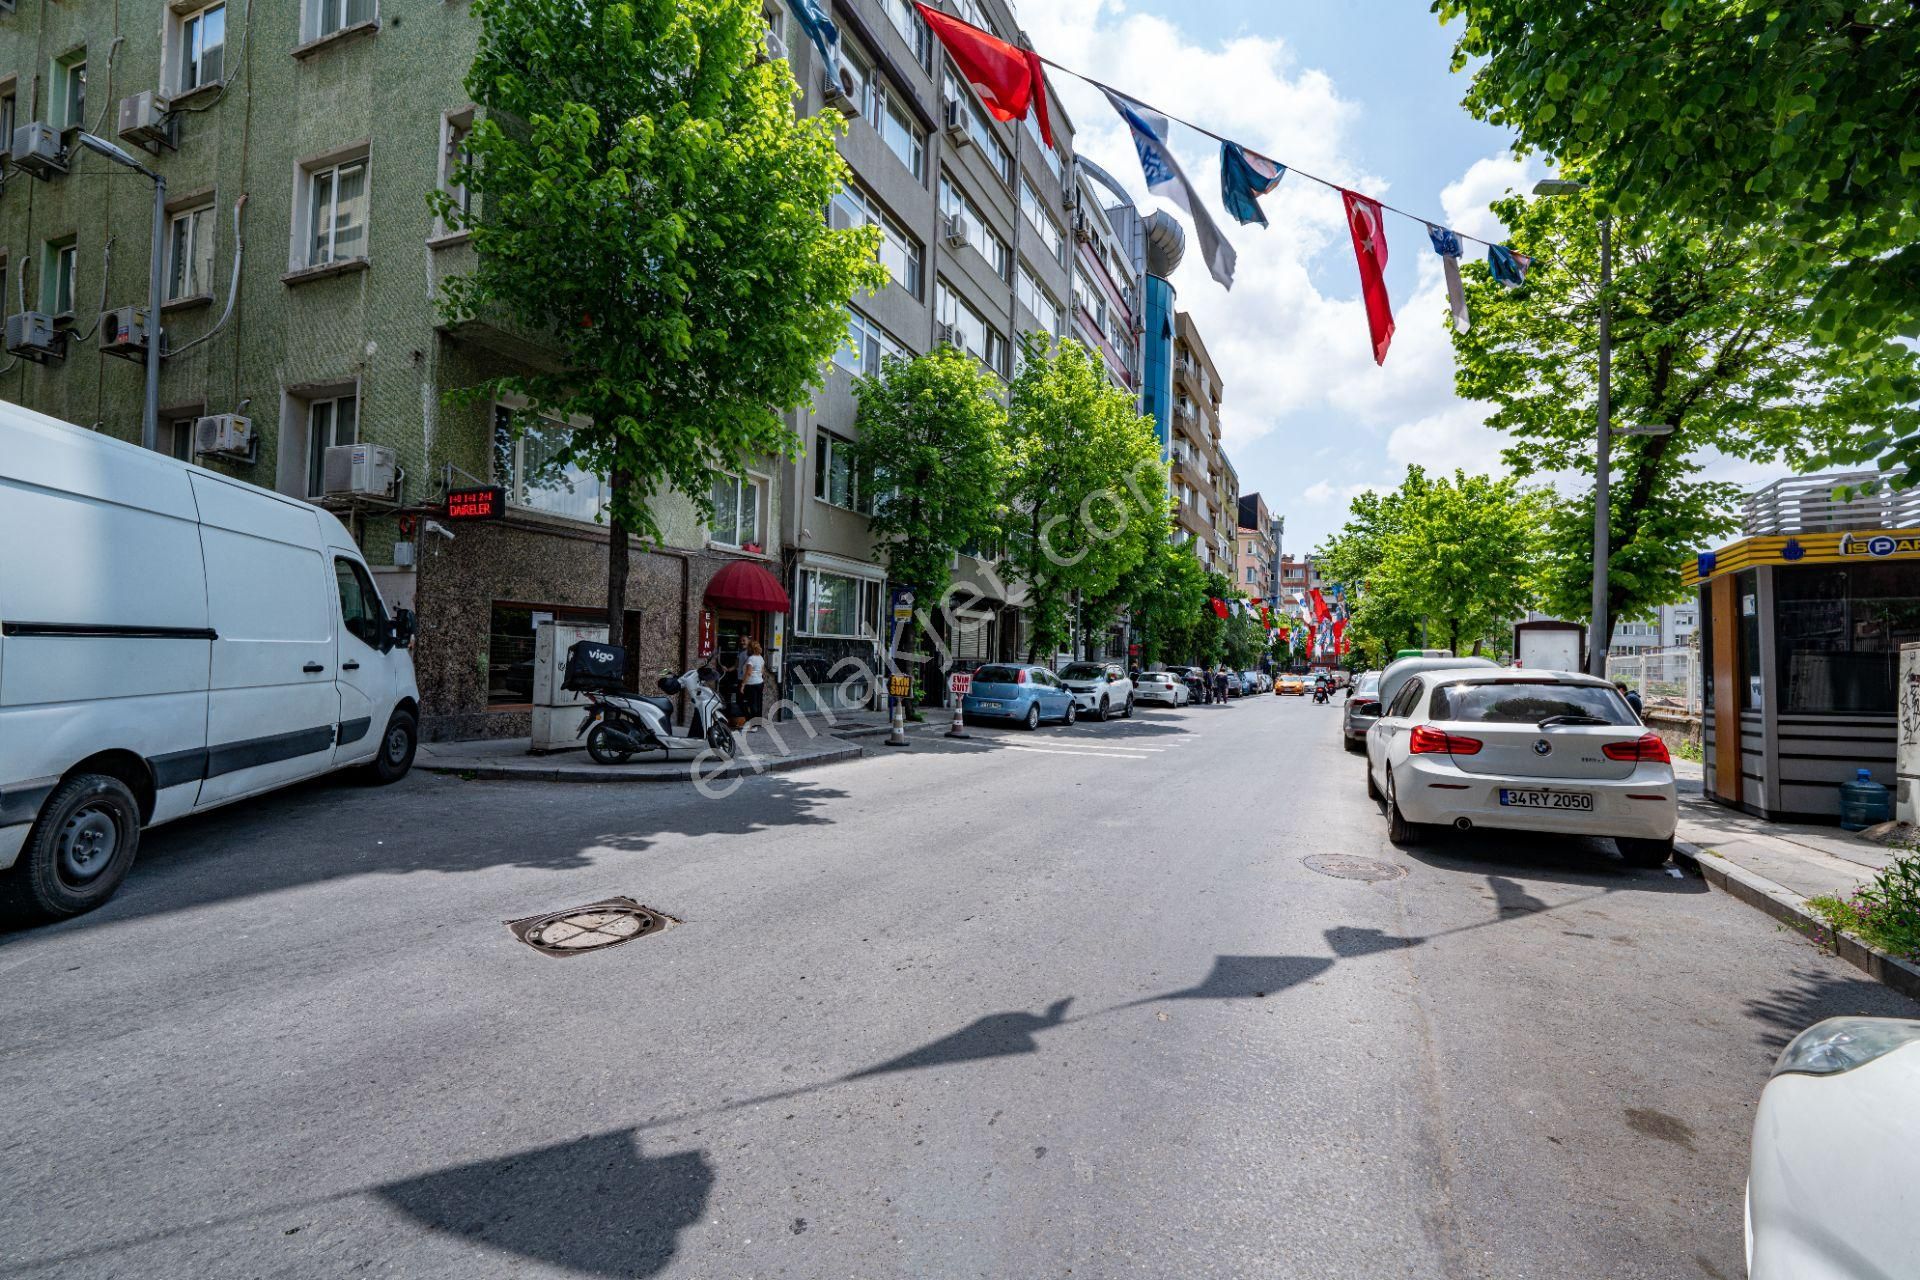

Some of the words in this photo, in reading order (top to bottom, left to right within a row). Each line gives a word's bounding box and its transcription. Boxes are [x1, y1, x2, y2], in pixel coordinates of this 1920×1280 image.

[588, 648, 614, 663] vigo
[1508, 791, 1527, 806] 34
[1529, 792, 1549, 807] RY
[1553, 793, 1590, 809] 2050
